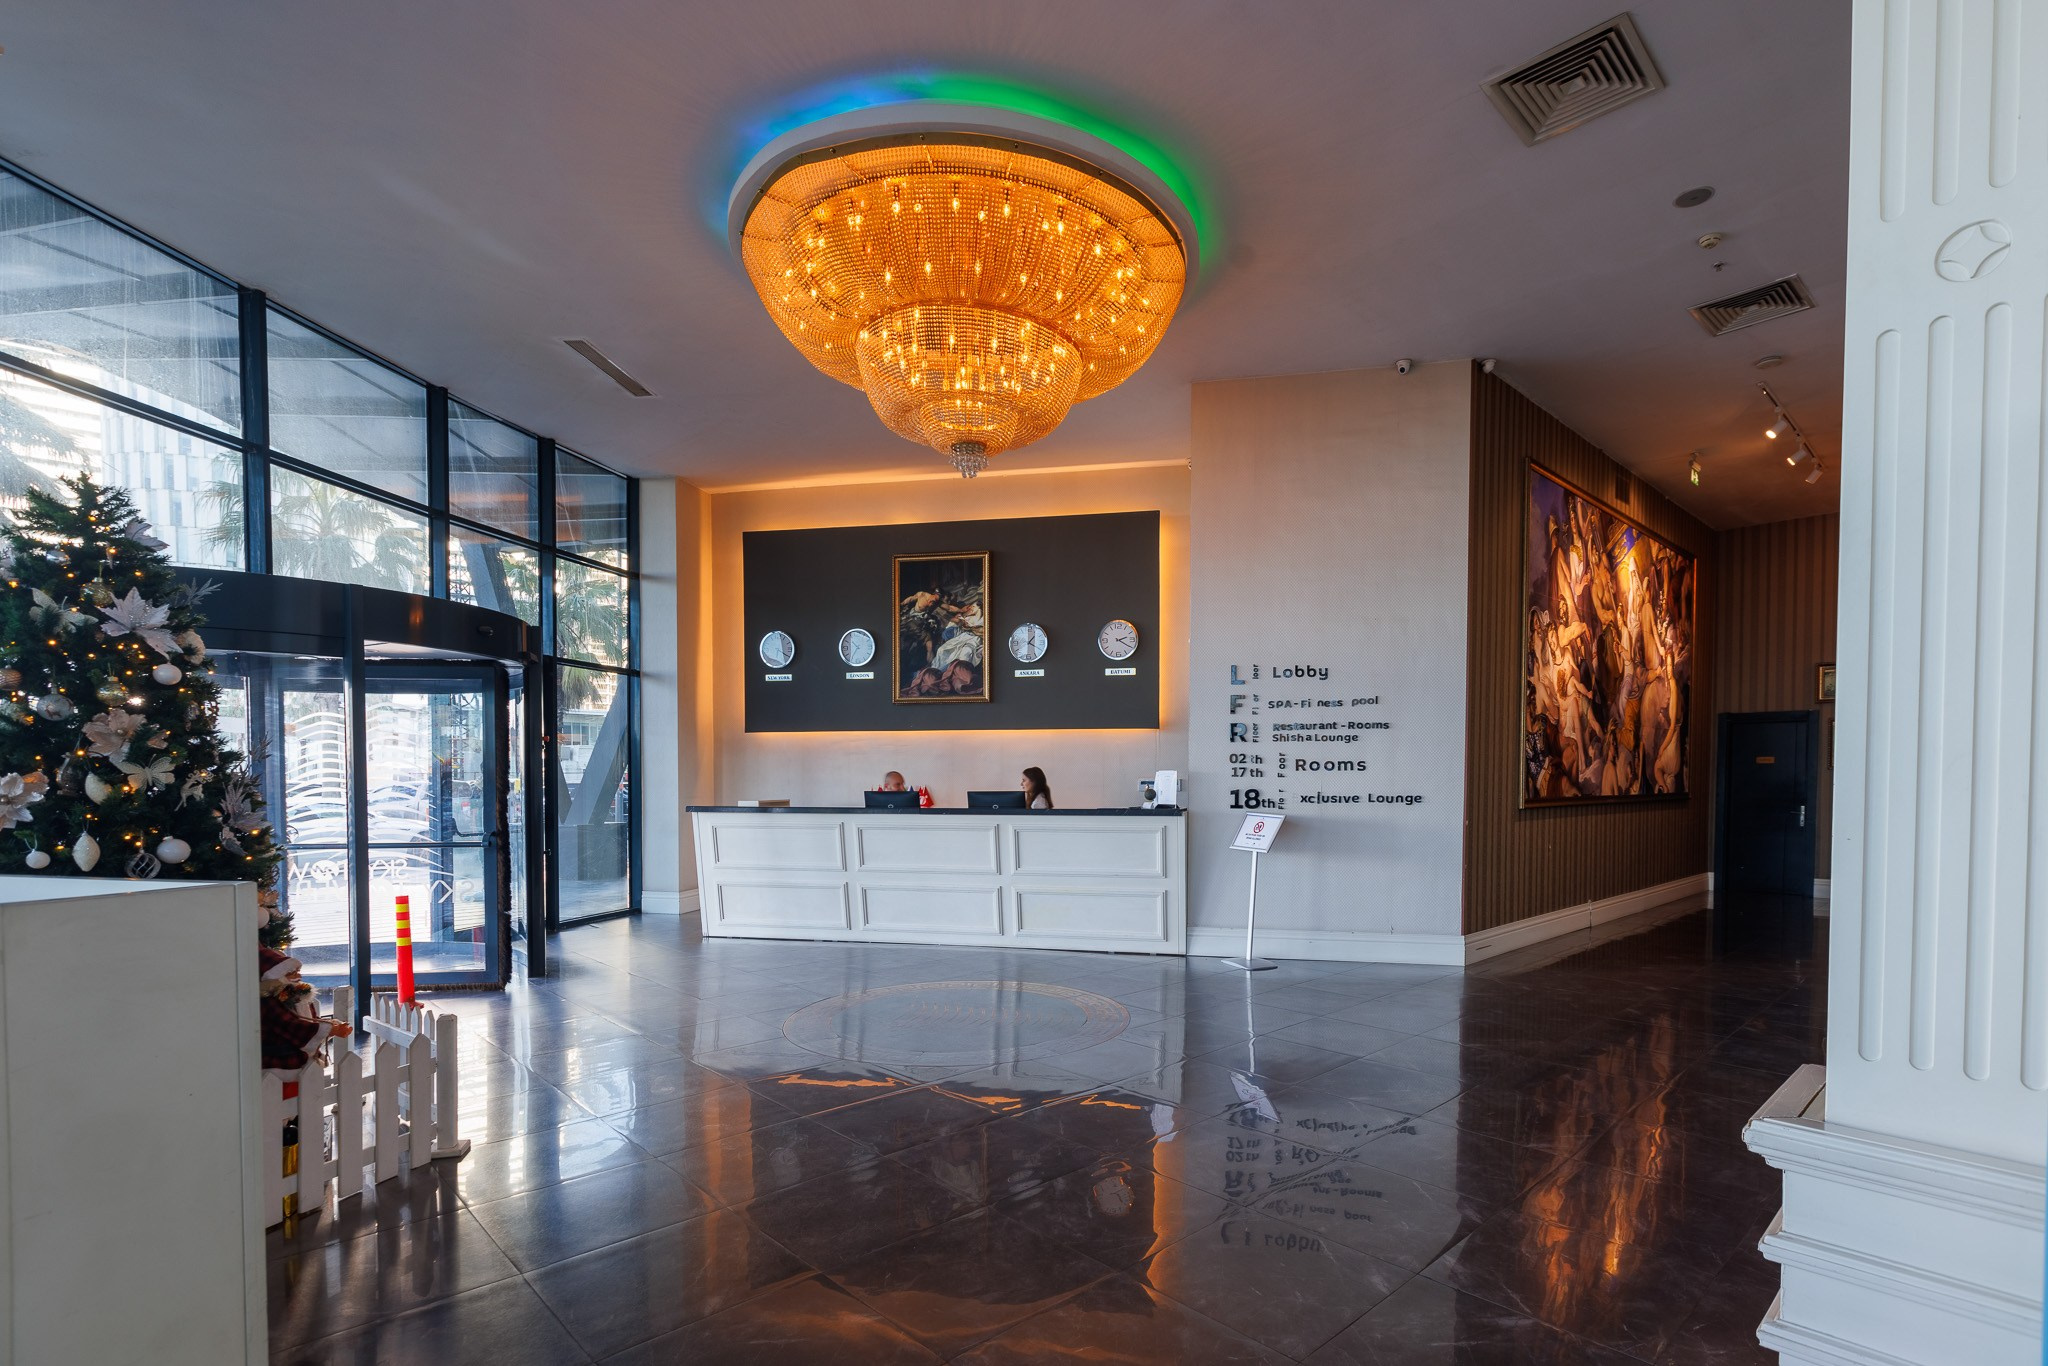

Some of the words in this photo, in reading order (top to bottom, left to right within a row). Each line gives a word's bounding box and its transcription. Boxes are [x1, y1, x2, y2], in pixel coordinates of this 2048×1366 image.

[1230, 664, 1246, 686] L
[1272, 665, 1329, 681] Lobby
[1230, 694, 1246, 715] F
[1351, 695, 1379, 707] pool
[1229, 723, 1248, 743] R
[1314, 733, 1359, 744] Lounge
[1295, 758, 1367, 772] Rooms
[1229, 788, 1276, 809] 18th
[1367, 793, 1423, 806] Lounge
